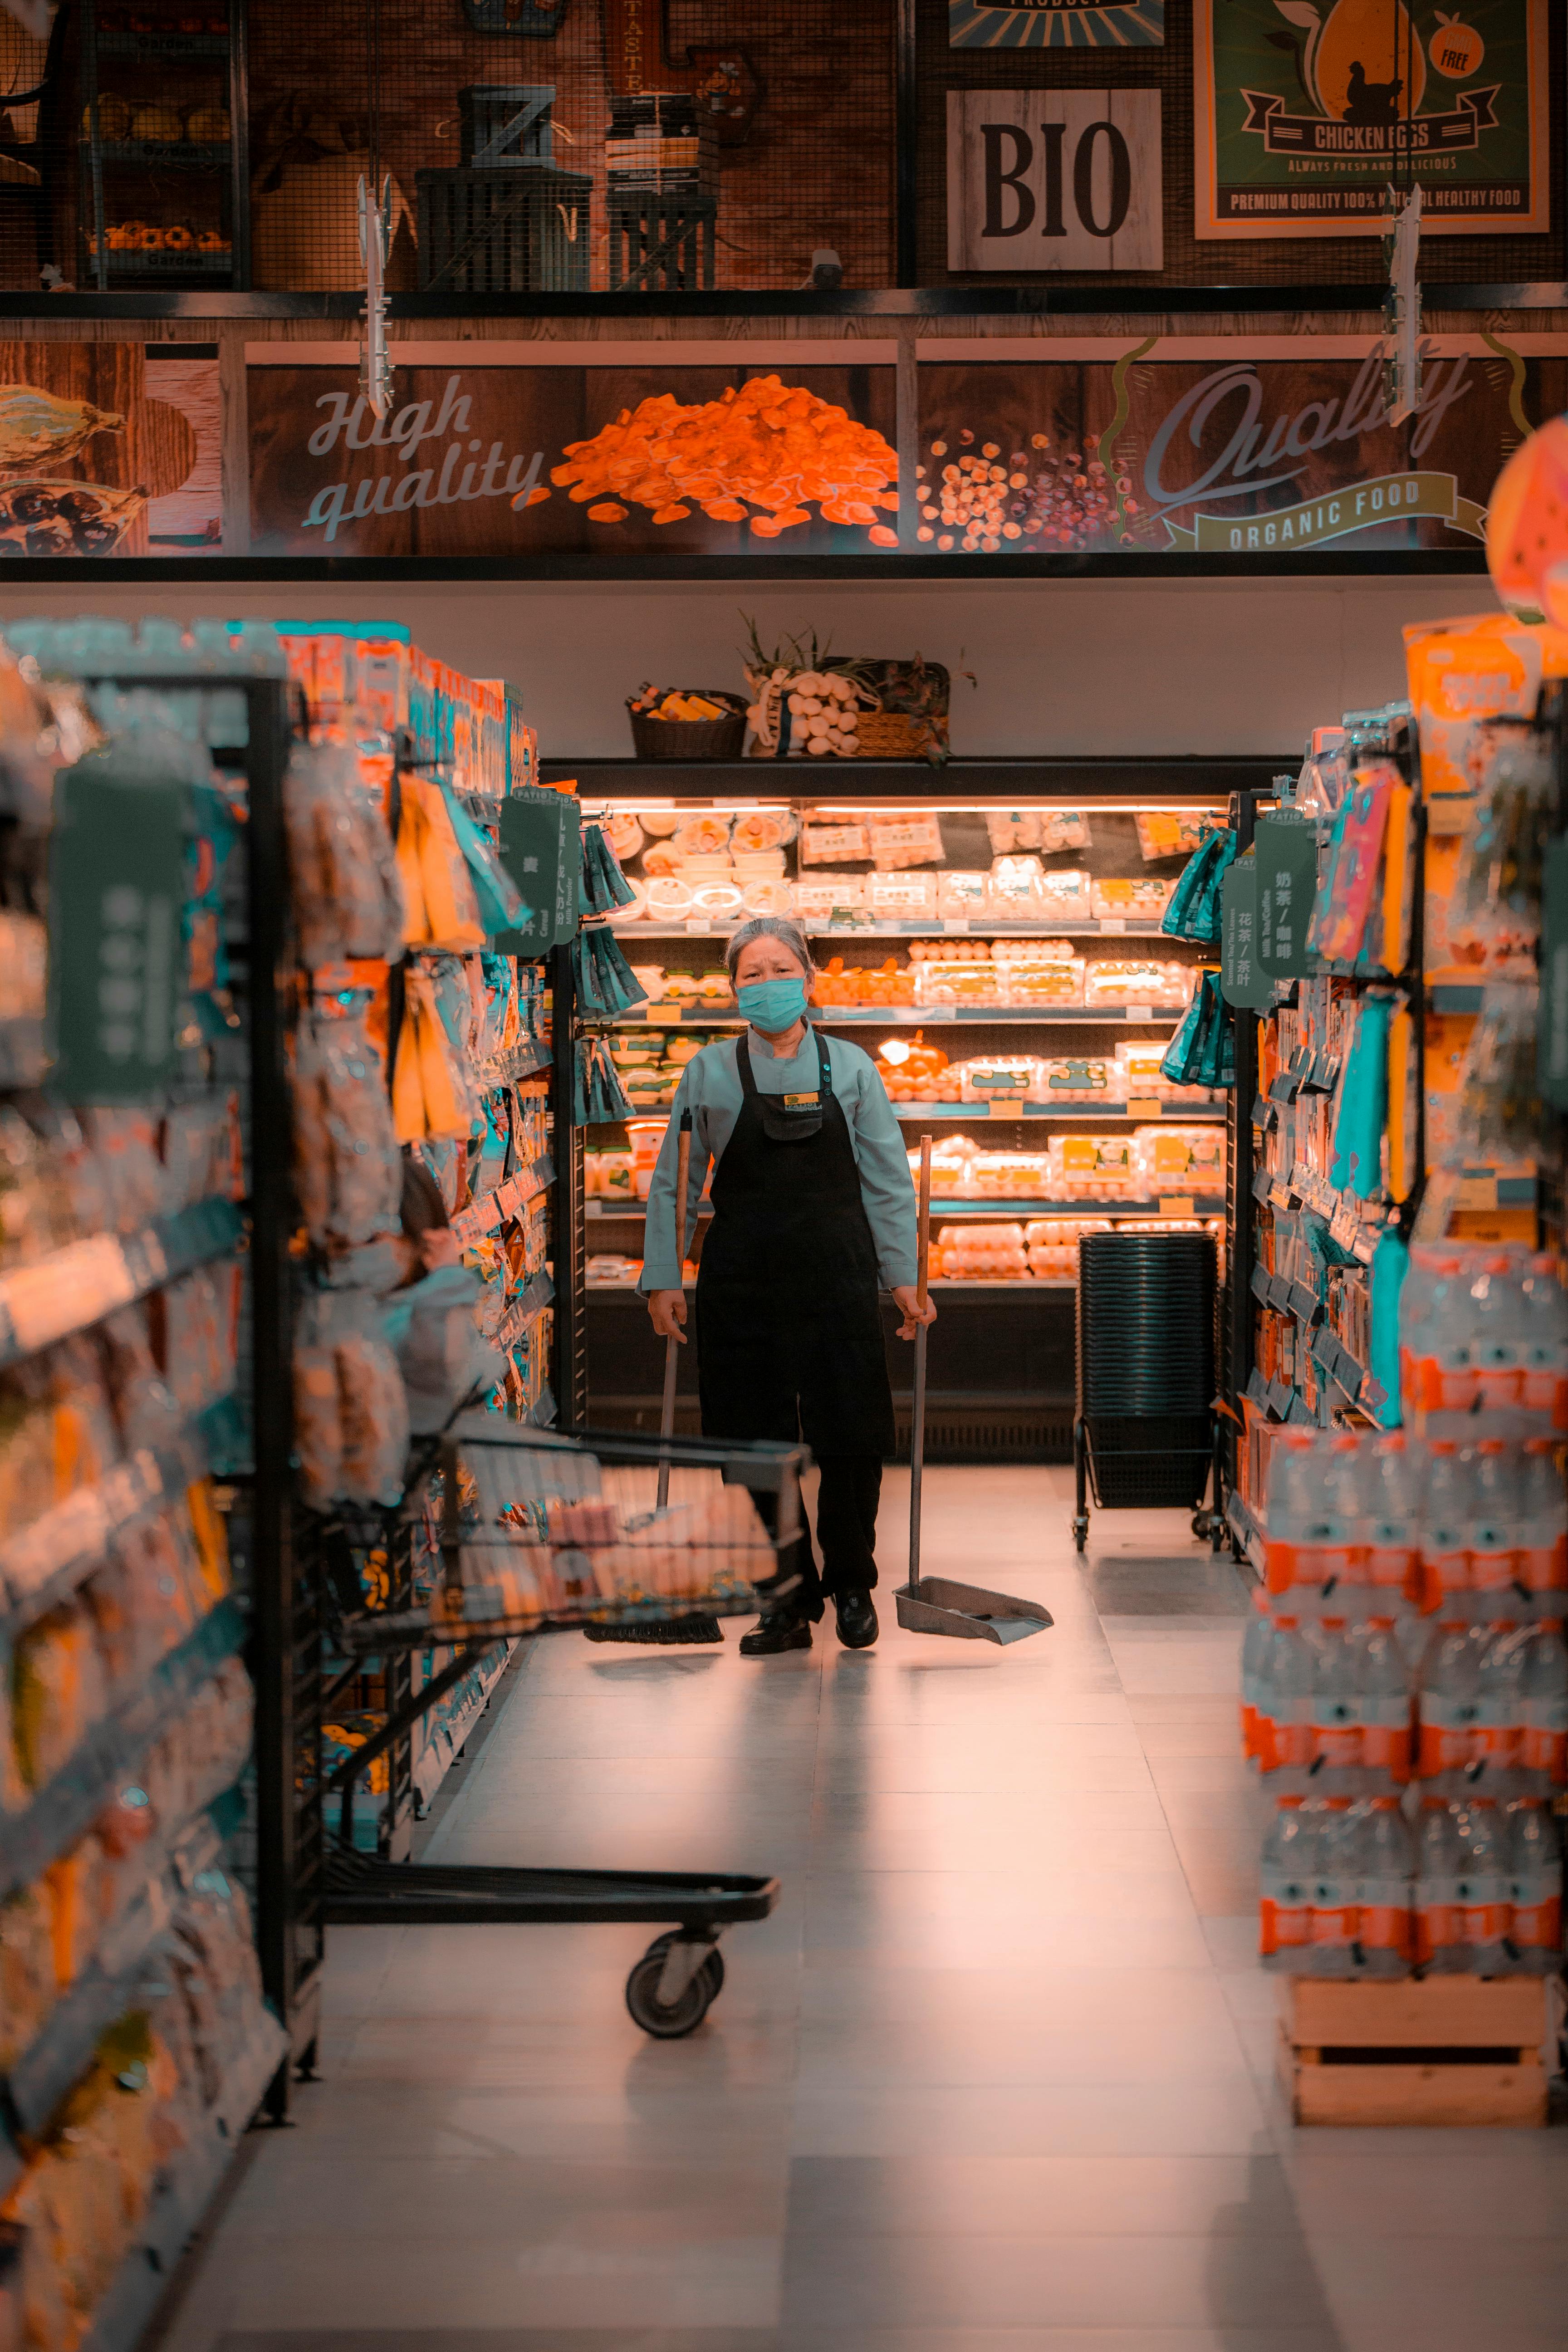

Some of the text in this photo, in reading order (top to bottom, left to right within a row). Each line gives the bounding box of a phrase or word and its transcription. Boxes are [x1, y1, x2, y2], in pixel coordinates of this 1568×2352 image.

[138, 35, 194, 49] Garden
[623, 1, 644, 90] TASTE
[1445, 31, 1473, 53] GMO
[1440, 49, 1469, 71] FREE
[1315, 123, 1429, 150] CHICKEN EGGS
[143, 144, 198, 157] Garden
[1288, 159, 1330, 172] ALWAYS
[1333, 162, 1368, 172] FRESH
[1371, 162, 1393, 171] AND
[980, 121, 1131, 238] BIO
[1230, 193, 1289, 210] PREMIUM
[1291, 193, 1341, 211] QUALITY
[1343, 192, 1375, 208] 100%
[1436, 190, 1487, 207] HEALTHY
[1489, 189, 1521, 206] FOOD
[148, 254, 204, 265] Garden
[308, 375, 472, 461] High
[300, 439, 545, 542] quality
[1230, 481, 1418, 550] ORGANIC FOOD
[517, 790, 548, 799] PATIO
[1270, 812, 1301, 821] PATIO
[539, 909, 549, 937] Cereal
[1261, 889, 1271, 958] Milk Tea/Coffee
[1276, 872, 1292, 960] 奶茶/咖啡
[1236, 912, 1253, 987] 花茶/茶叶
